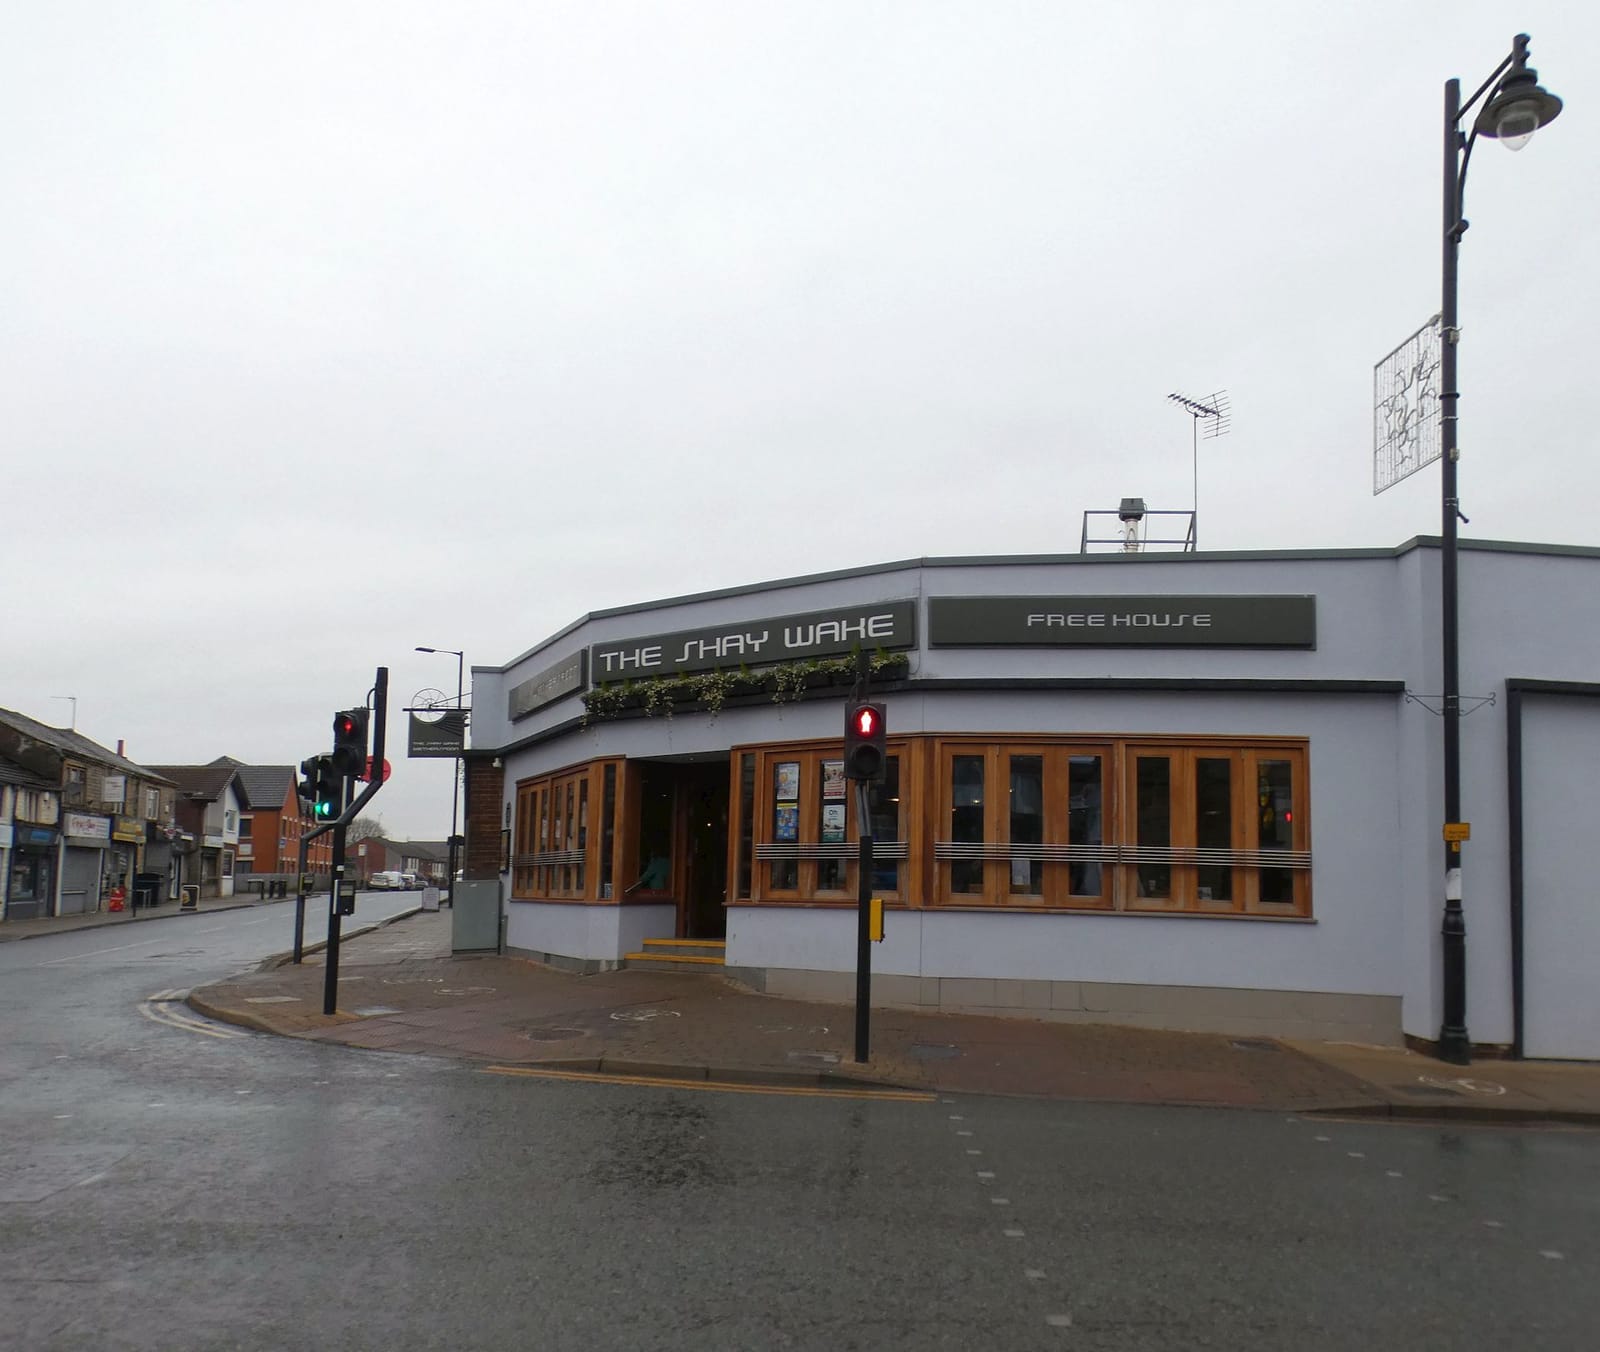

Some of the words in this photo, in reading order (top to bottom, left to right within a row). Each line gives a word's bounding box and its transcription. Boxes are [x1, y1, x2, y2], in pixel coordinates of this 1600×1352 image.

[1027, 614, 1105, 627] FREE
[1113, 614, 1212, 627] HOUSE
[599, 645, 662, 672] THE
[674, 630, 769, 662] SHAY
[783, 613, 894, 648] WAKE
